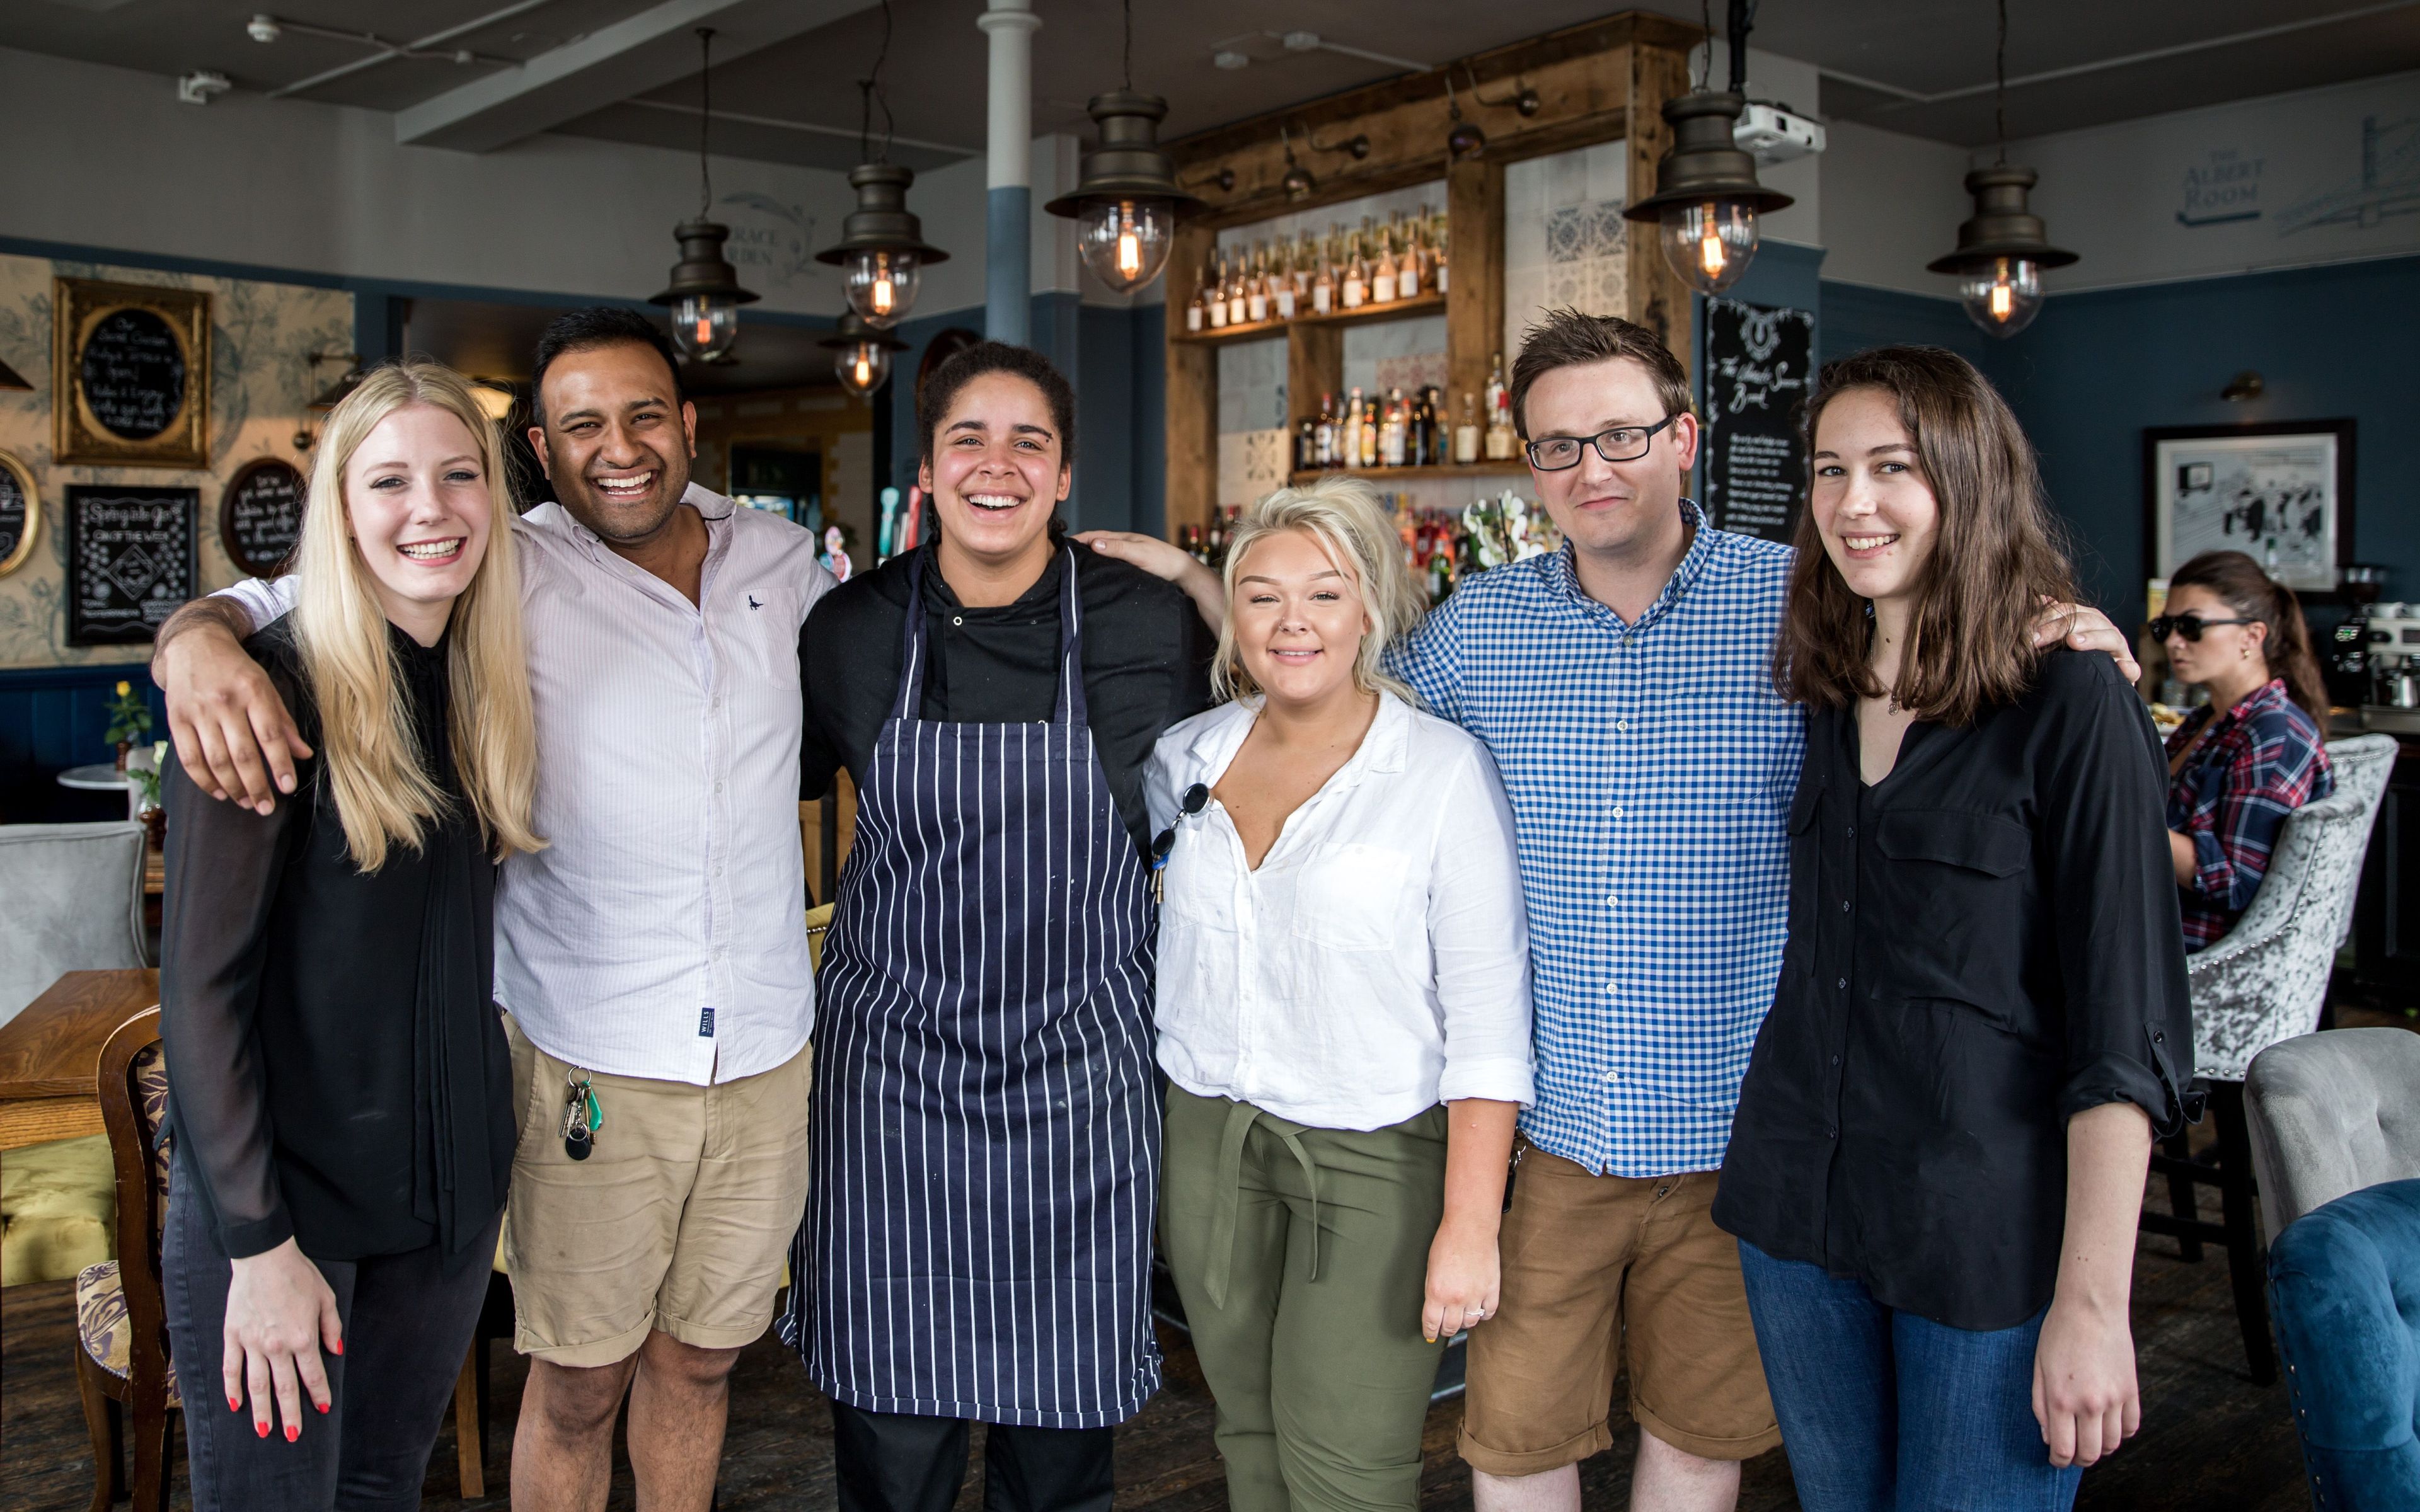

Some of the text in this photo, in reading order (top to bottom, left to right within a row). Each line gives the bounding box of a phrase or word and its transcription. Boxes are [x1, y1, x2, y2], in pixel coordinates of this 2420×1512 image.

[2185, 184, 2259, 210] ROOM
[88, 503, 129, 529] Spring
[125, 530, 143, 543] THE
[143, 530, 170, 543] WEEK
[701, 1011, 709, 1033] WILLS
